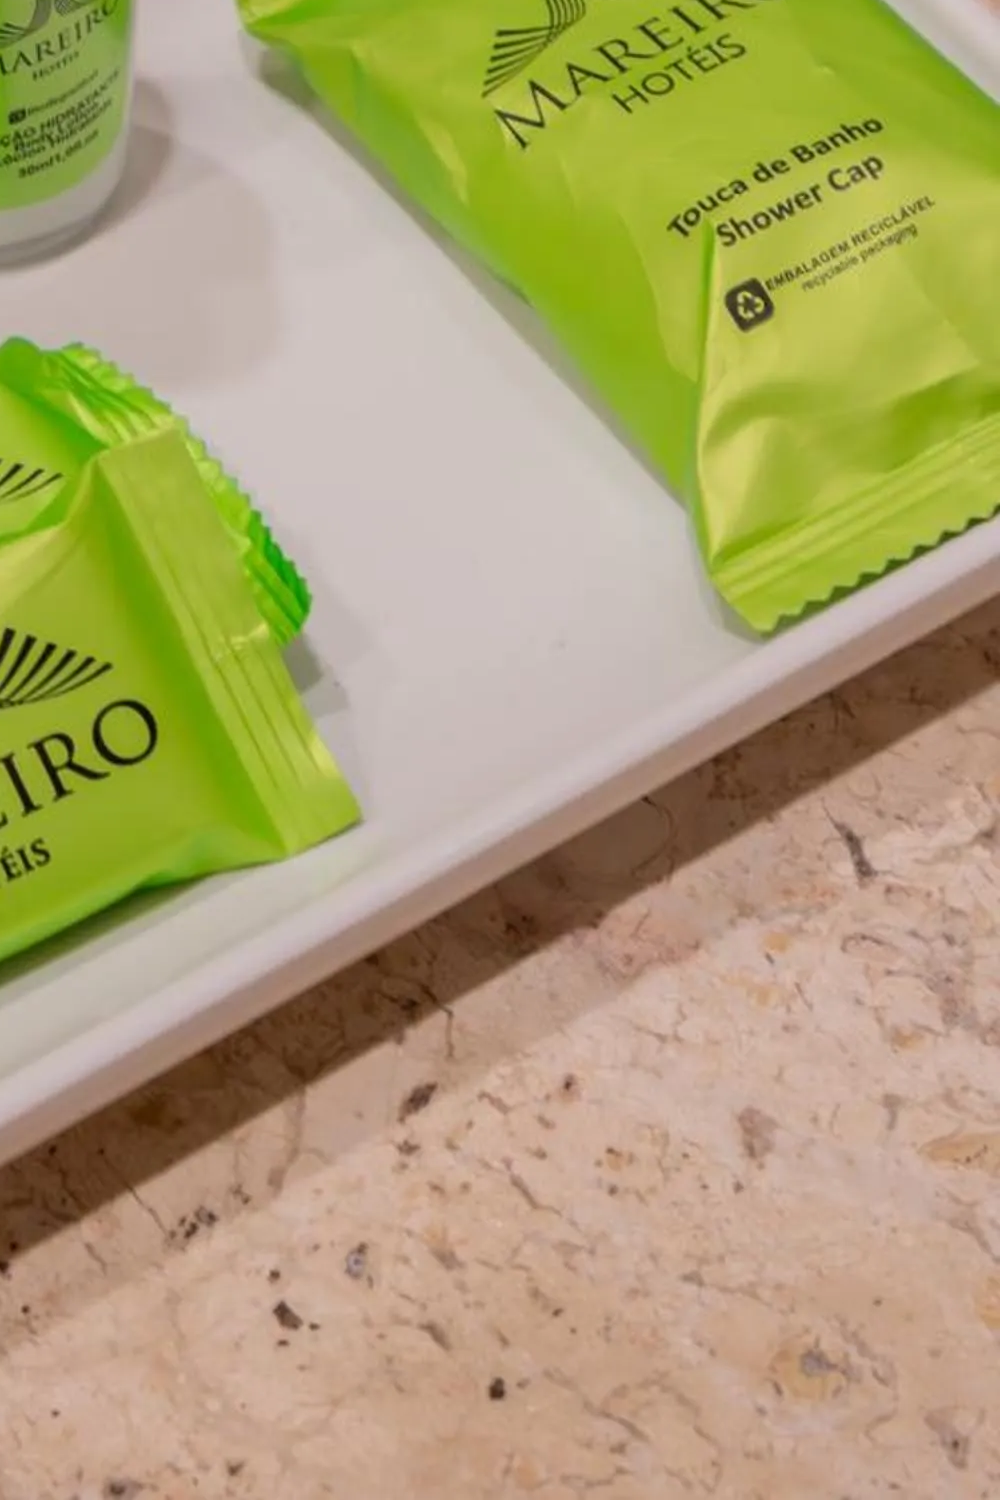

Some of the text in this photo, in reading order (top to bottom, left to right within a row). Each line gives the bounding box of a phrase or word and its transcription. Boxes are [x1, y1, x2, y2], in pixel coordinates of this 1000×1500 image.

[611, 32, 747, 115] HOTÉIS
[666, 116, 885, 240] Touca de Banho
[715, 154, 885, 248] Shower Cap
[763, 195, 936, 292] EMBALAGEM RECICLÁVEL
